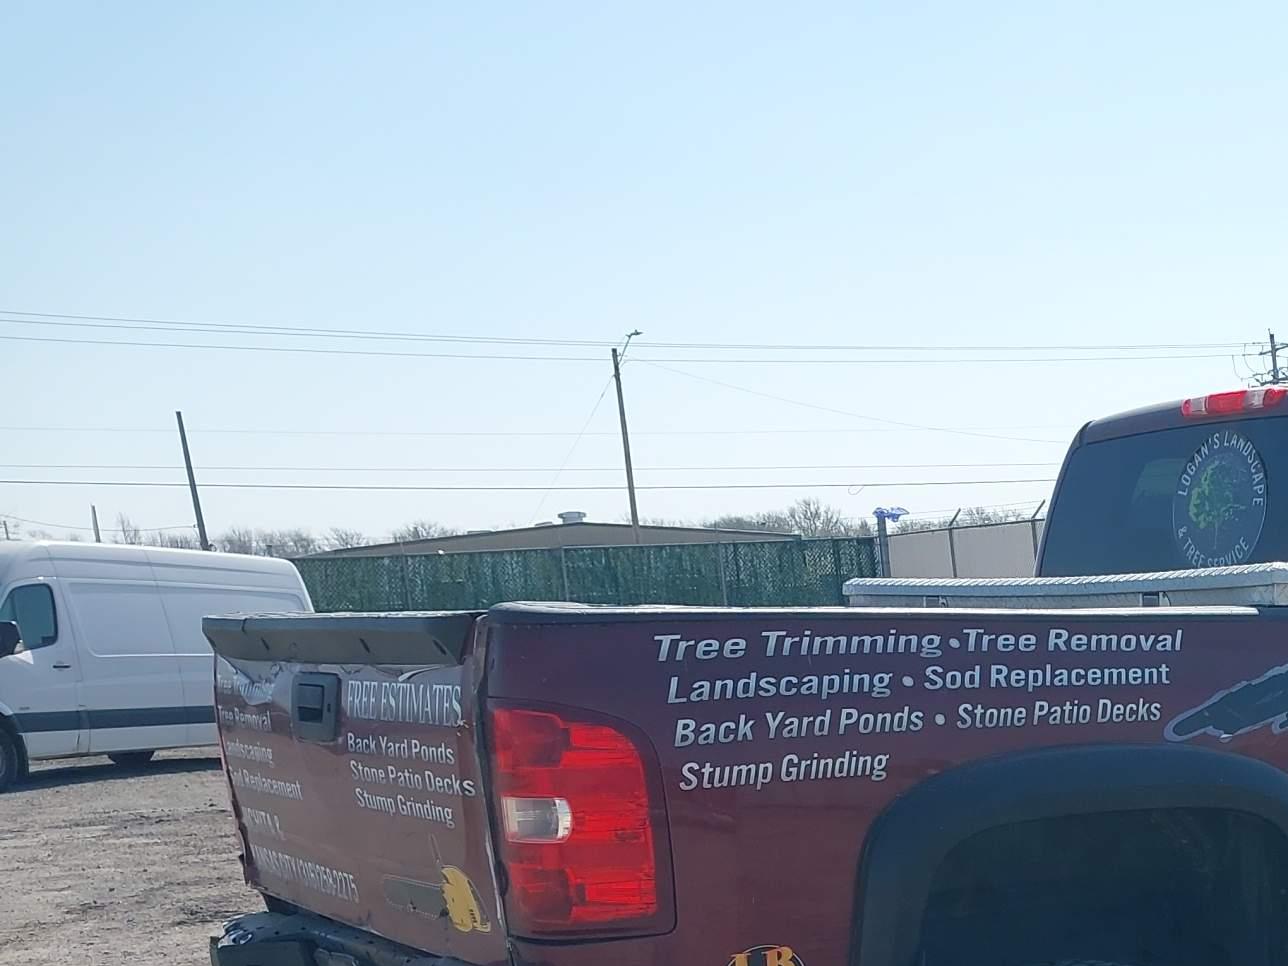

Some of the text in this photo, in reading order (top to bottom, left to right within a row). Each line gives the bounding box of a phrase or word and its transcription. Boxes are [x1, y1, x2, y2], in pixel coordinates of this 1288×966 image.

[1178, 431, 1265, 506] LOGAN'S LANDSCAPE
[654, 628, 1183, 662] Tree Trimming Tree Removal
[667, 663, 1170, 704] Landscaping Sod Replacement
[234, 707, 272, 734] Removal
[347, 680, 463, 728] FREE ESTIMATES
[674, 698, 1161, 747] Back Yard Ponds Stone Patio Decks
[225, 738, 274, 768] andscaping
[348, 733, 456, 765] Back Yard Ponds
[243, 768, 304, 800] Replacement
[350, 760, 476, 797] Stone Patio Decks
[679, 750, 890, 792] Stump Grinding
[355, 787, 456, 829] Stump Grinding
